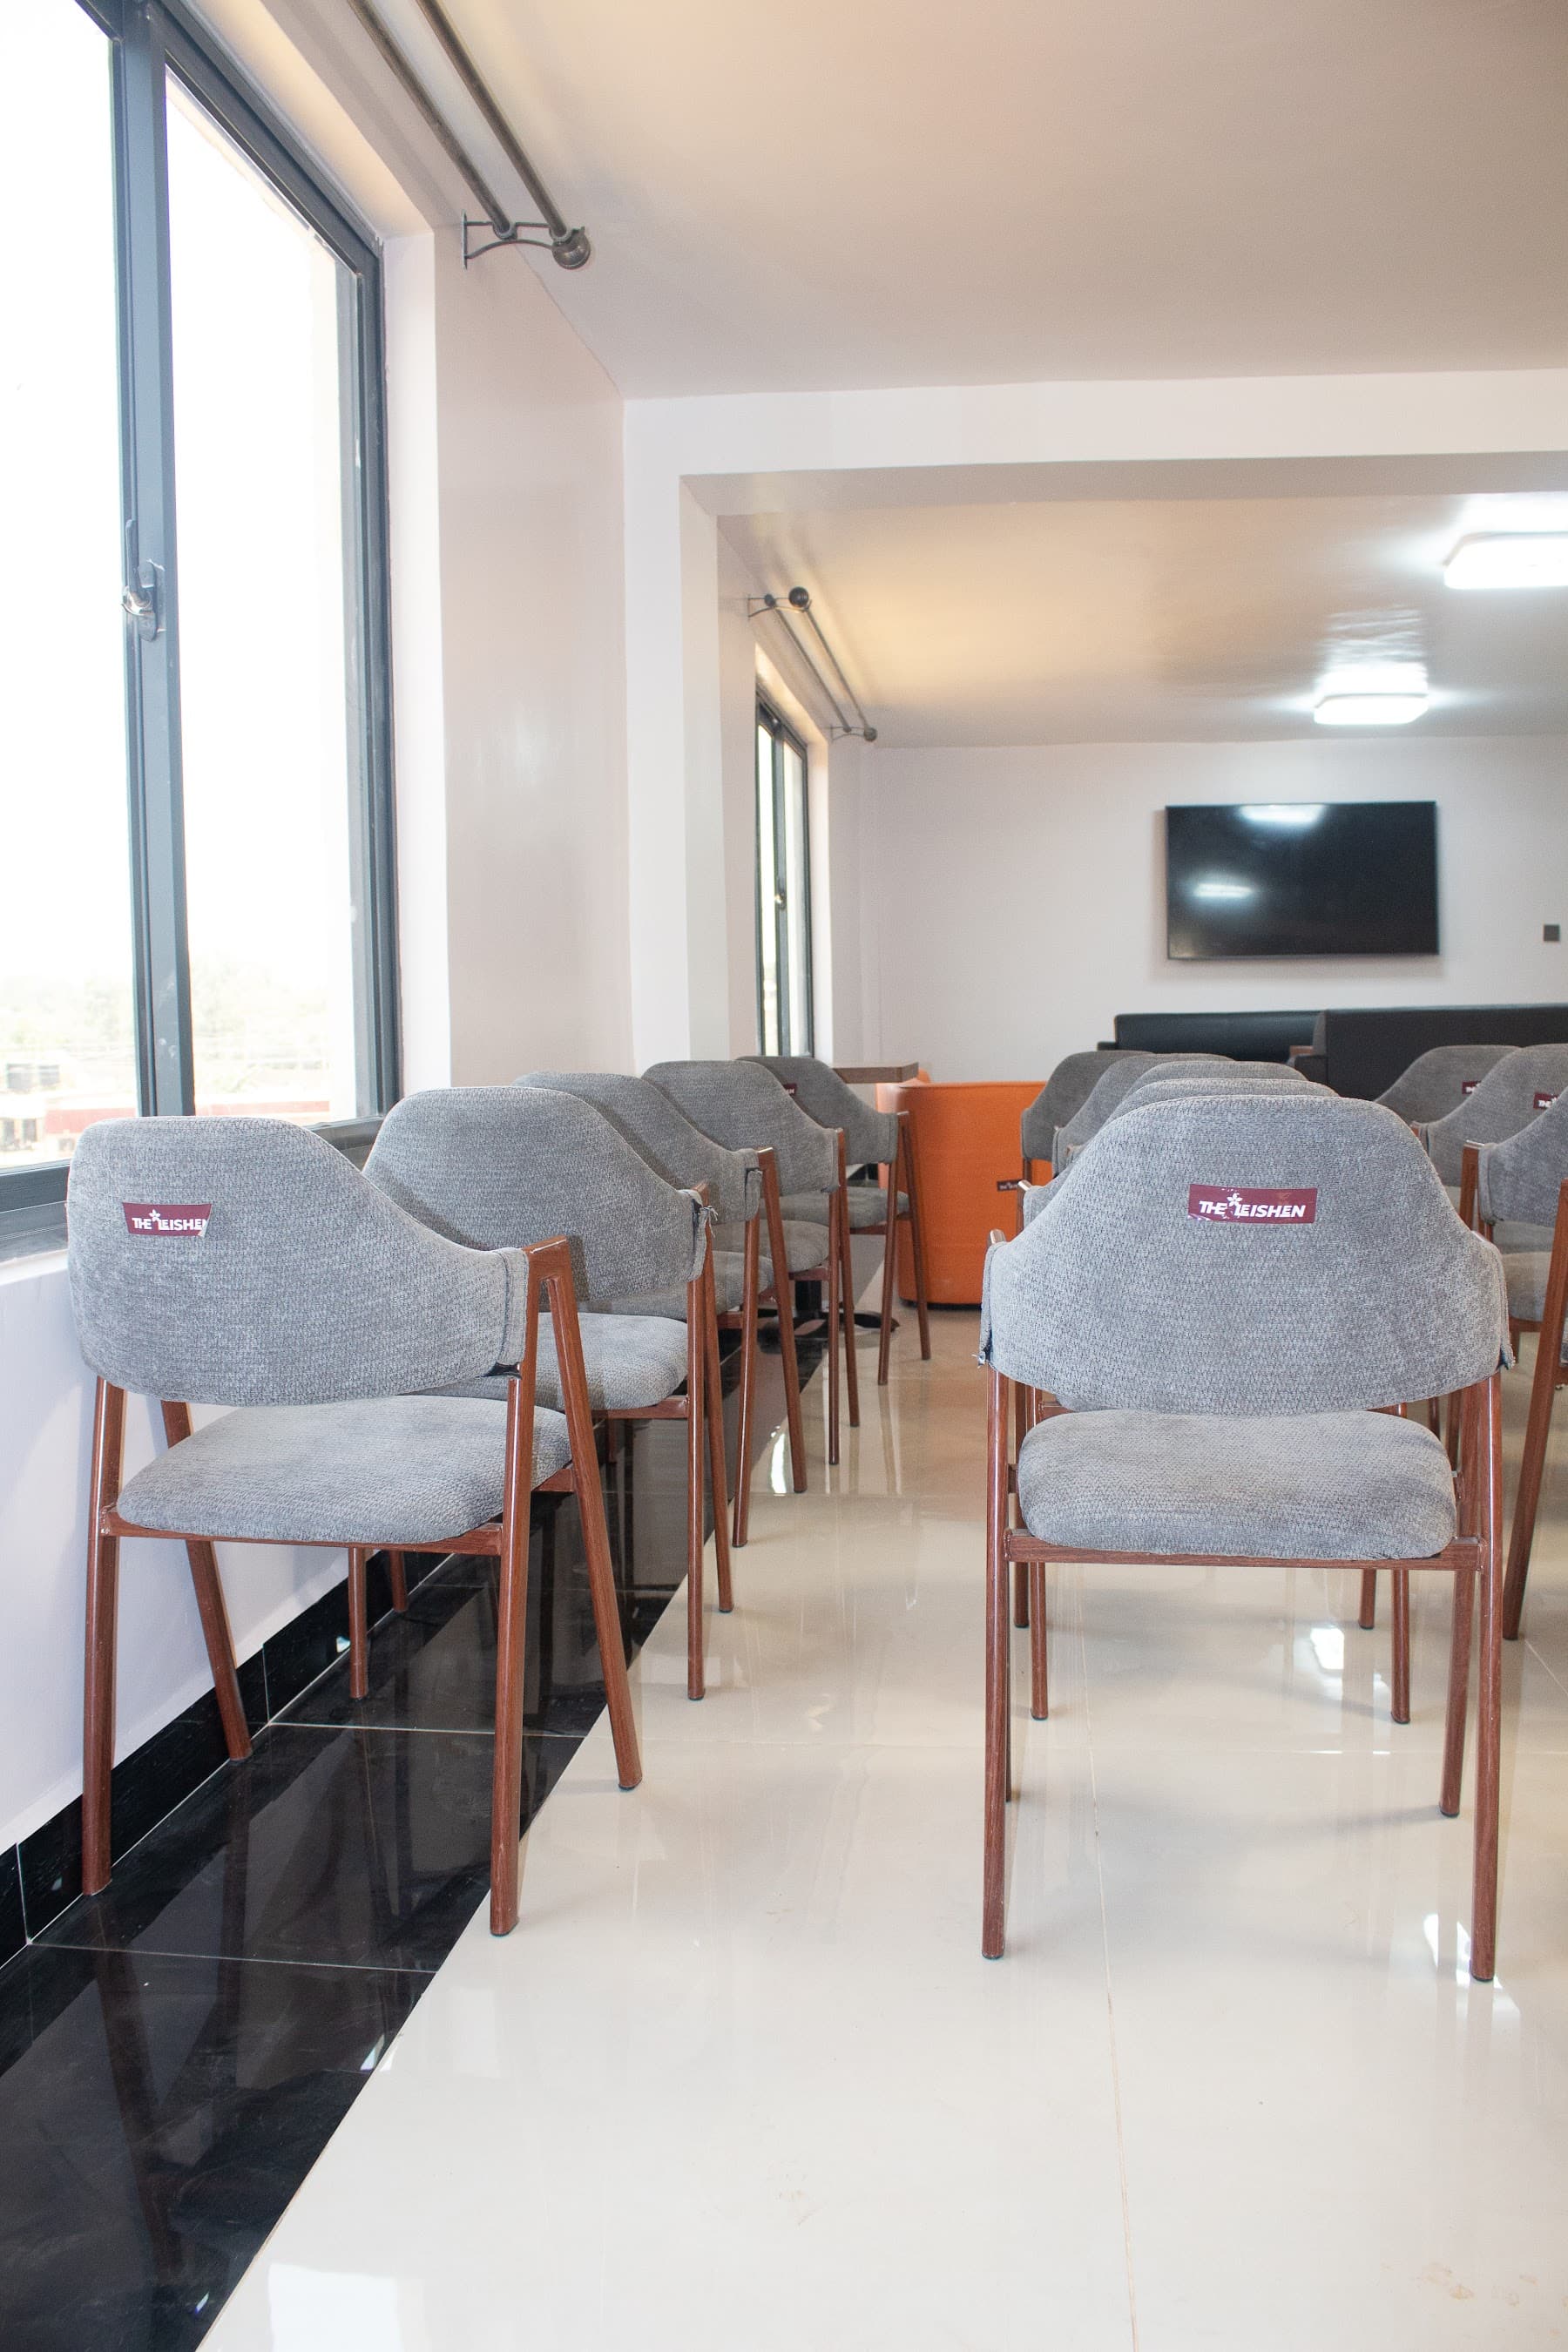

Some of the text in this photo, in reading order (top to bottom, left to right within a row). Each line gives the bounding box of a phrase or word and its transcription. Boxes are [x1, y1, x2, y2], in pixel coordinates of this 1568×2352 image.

[1199, 1200, 1306, 1218] THE LEISHEN
[132, 1217, 152, 1230] THE
